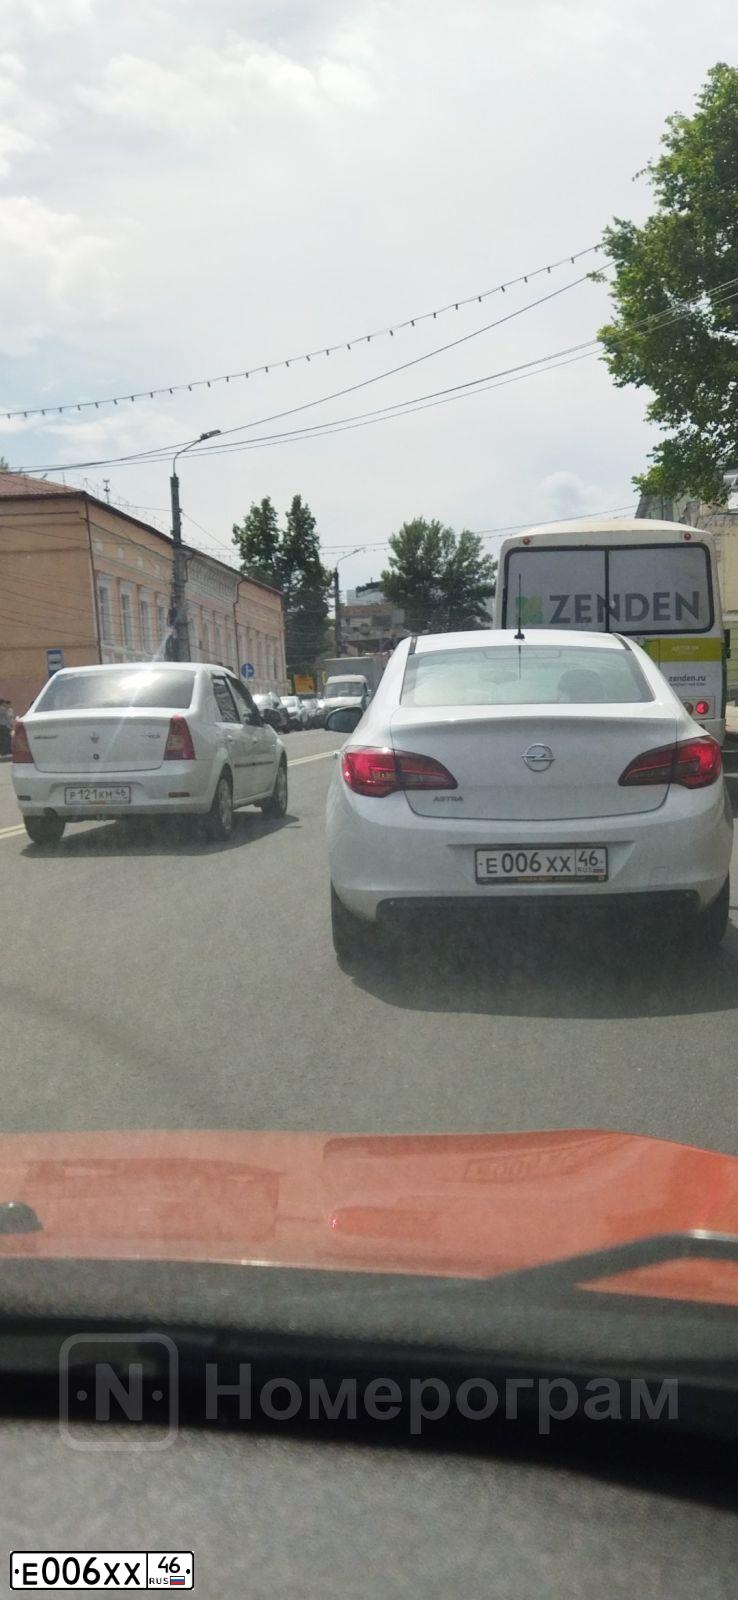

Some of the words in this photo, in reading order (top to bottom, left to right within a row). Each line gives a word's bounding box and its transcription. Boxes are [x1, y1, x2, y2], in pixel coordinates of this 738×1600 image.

[549, 591, 700, 624] ZENDEN
[668, 673, 707, 682] zenden.ru
[579, 851, 598, 866] 46
